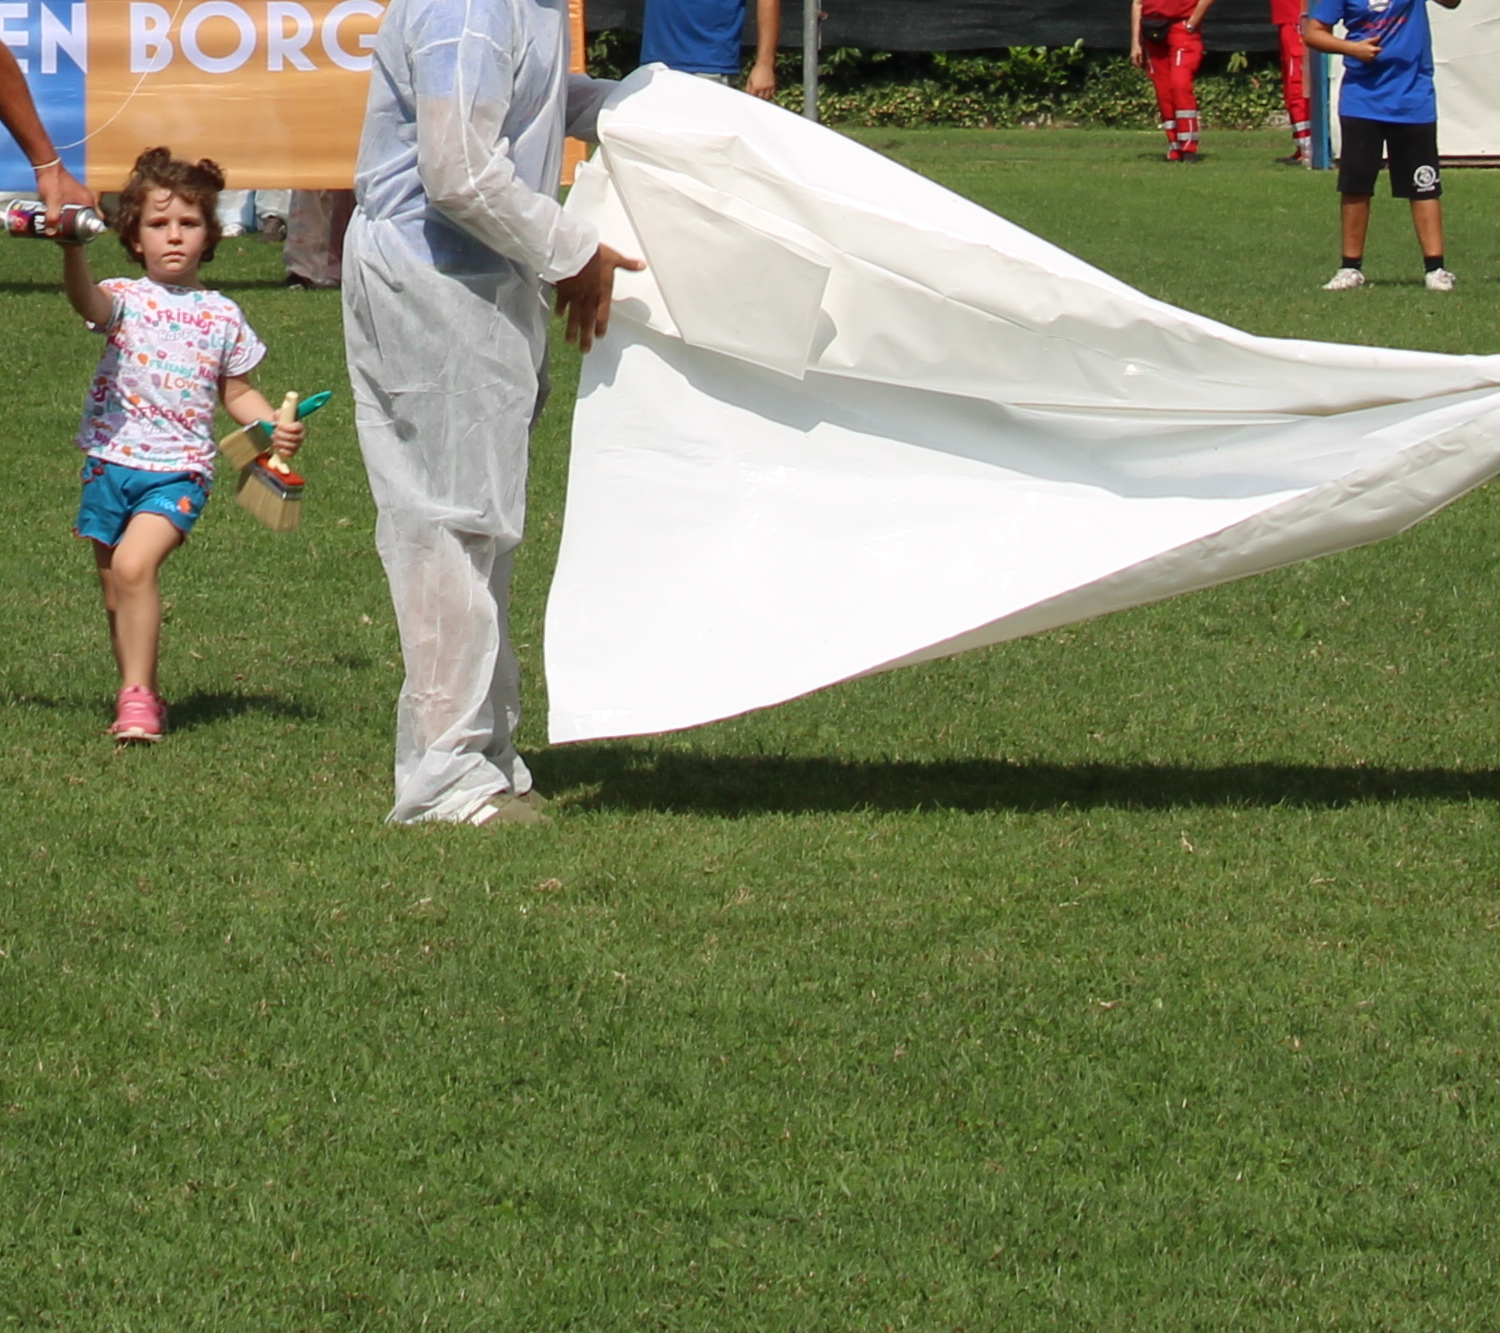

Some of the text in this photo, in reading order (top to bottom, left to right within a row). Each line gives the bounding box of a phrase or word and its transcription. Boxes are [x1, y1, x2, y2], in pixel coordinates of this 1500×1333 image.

[157, 307, 216, 336] FRIENDS
[149, 359, 196, 379] FRIENDS
[163, 371, 200, 391] LOVE
